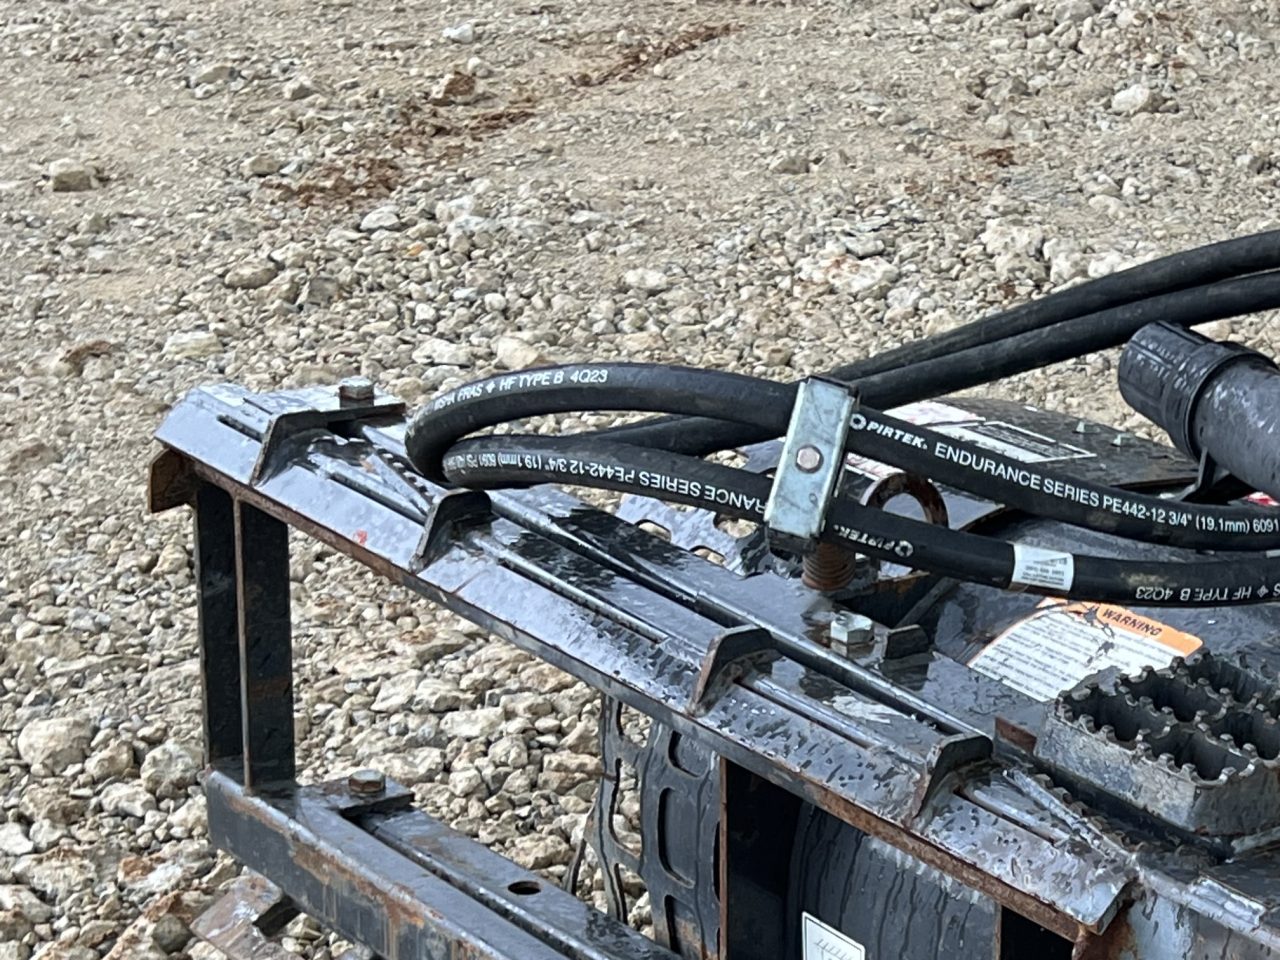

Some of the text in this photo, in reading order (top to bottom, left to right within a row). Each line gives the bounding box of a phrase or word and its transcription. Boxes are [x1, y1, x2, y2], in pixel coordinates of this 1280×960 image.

[457, 382, 483, 402] FRAS
[499, 376, 515, 391] HF
[519, 372, 551, 387] TYPE
[553, 370, 564, 384] B
[570, 369, 608, 384] 4Q23
[499, 452, 541, 470] (19.1mm)
[545, 458, 568, 471] 3/4"
[570, 459, 635, 483] PE442-12
[639, 470, 702, 497] SERIES
[866, 422, 922, 449] PIRTEK
[935, 442, 1041, 490] ENDURANCE
[1043, 478, 1100, 508] SERIES
[1103, 495, 1165, 524] PE442-12
[1169, 510, 1192, 526] 3/4"
[1195, 515, 1250, 533] (19.1mm)
[1253, 517, 1279, 533] 6091
[704, 486, 768, 514] RANCE
[1135, 586, 1173, 600] 4Q23
[1180, 588, 1191, 601] B
[1195, 587, 1229, 600] TYPE
[1232, 586, 1252, 600] HF
[1102, 607, 1162, 637] WARNING
